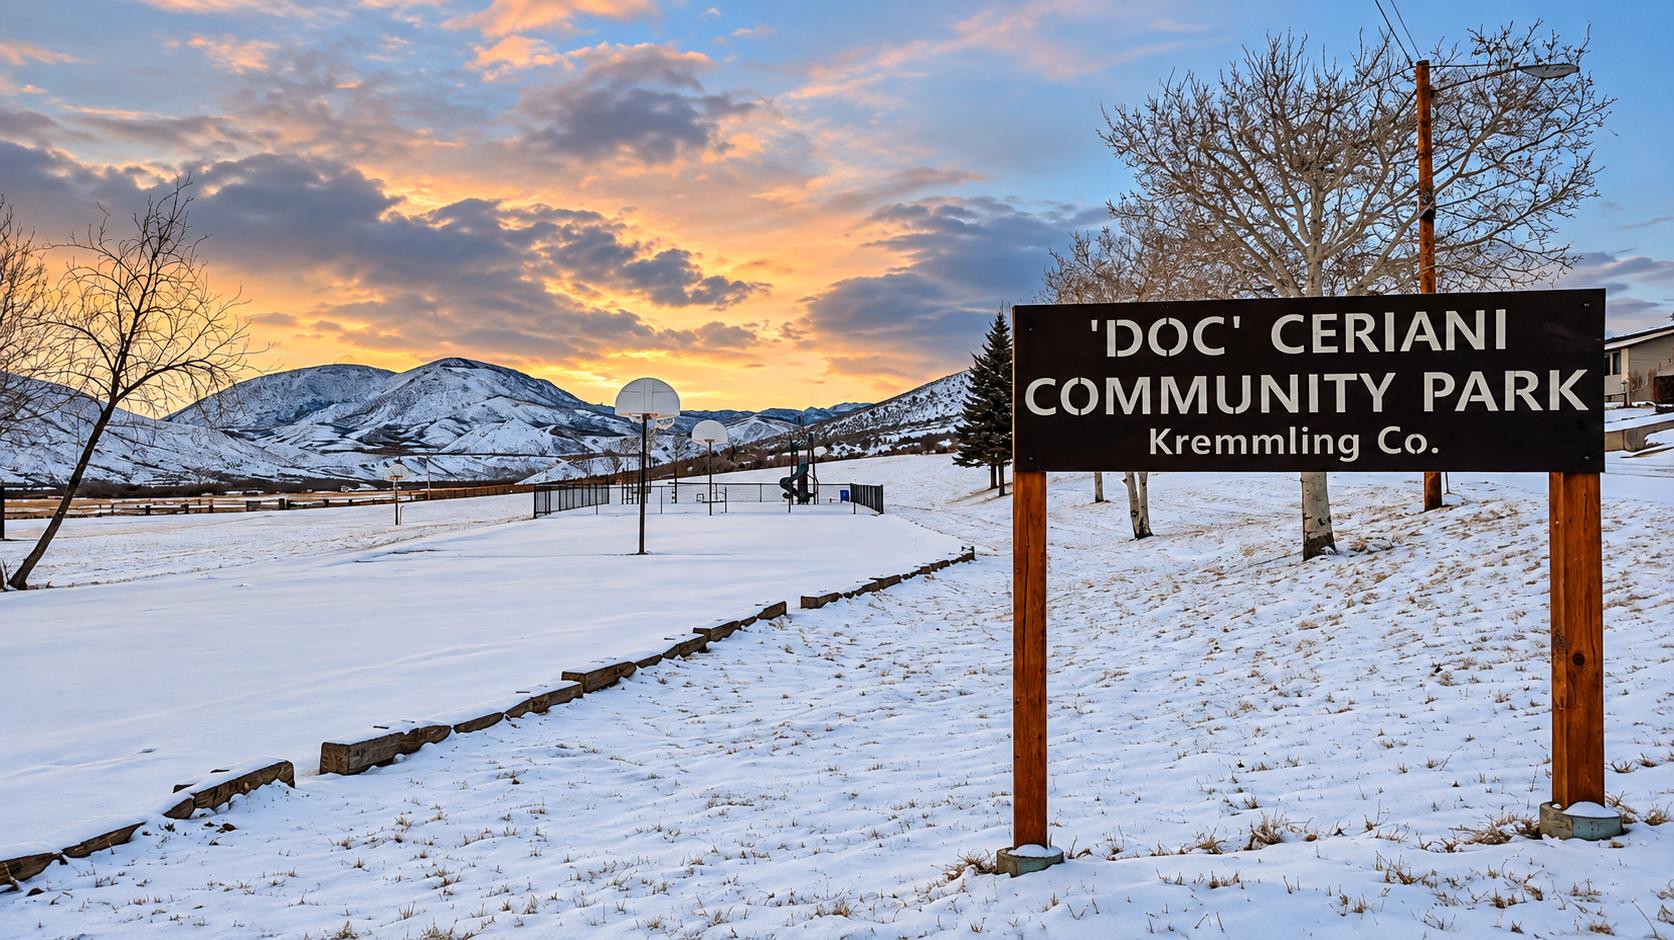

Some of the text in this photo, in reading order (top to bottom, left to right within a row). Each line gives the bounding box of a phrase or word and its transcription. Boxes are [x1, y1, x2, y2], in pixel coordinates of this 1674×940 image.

[1090, 309, 1507, 358] 'DOC' CERIANI
[1024, 369, 1590, 416] COMMUNITY PARK
[1149, 425, 1439, 463] Kremmling Co.
